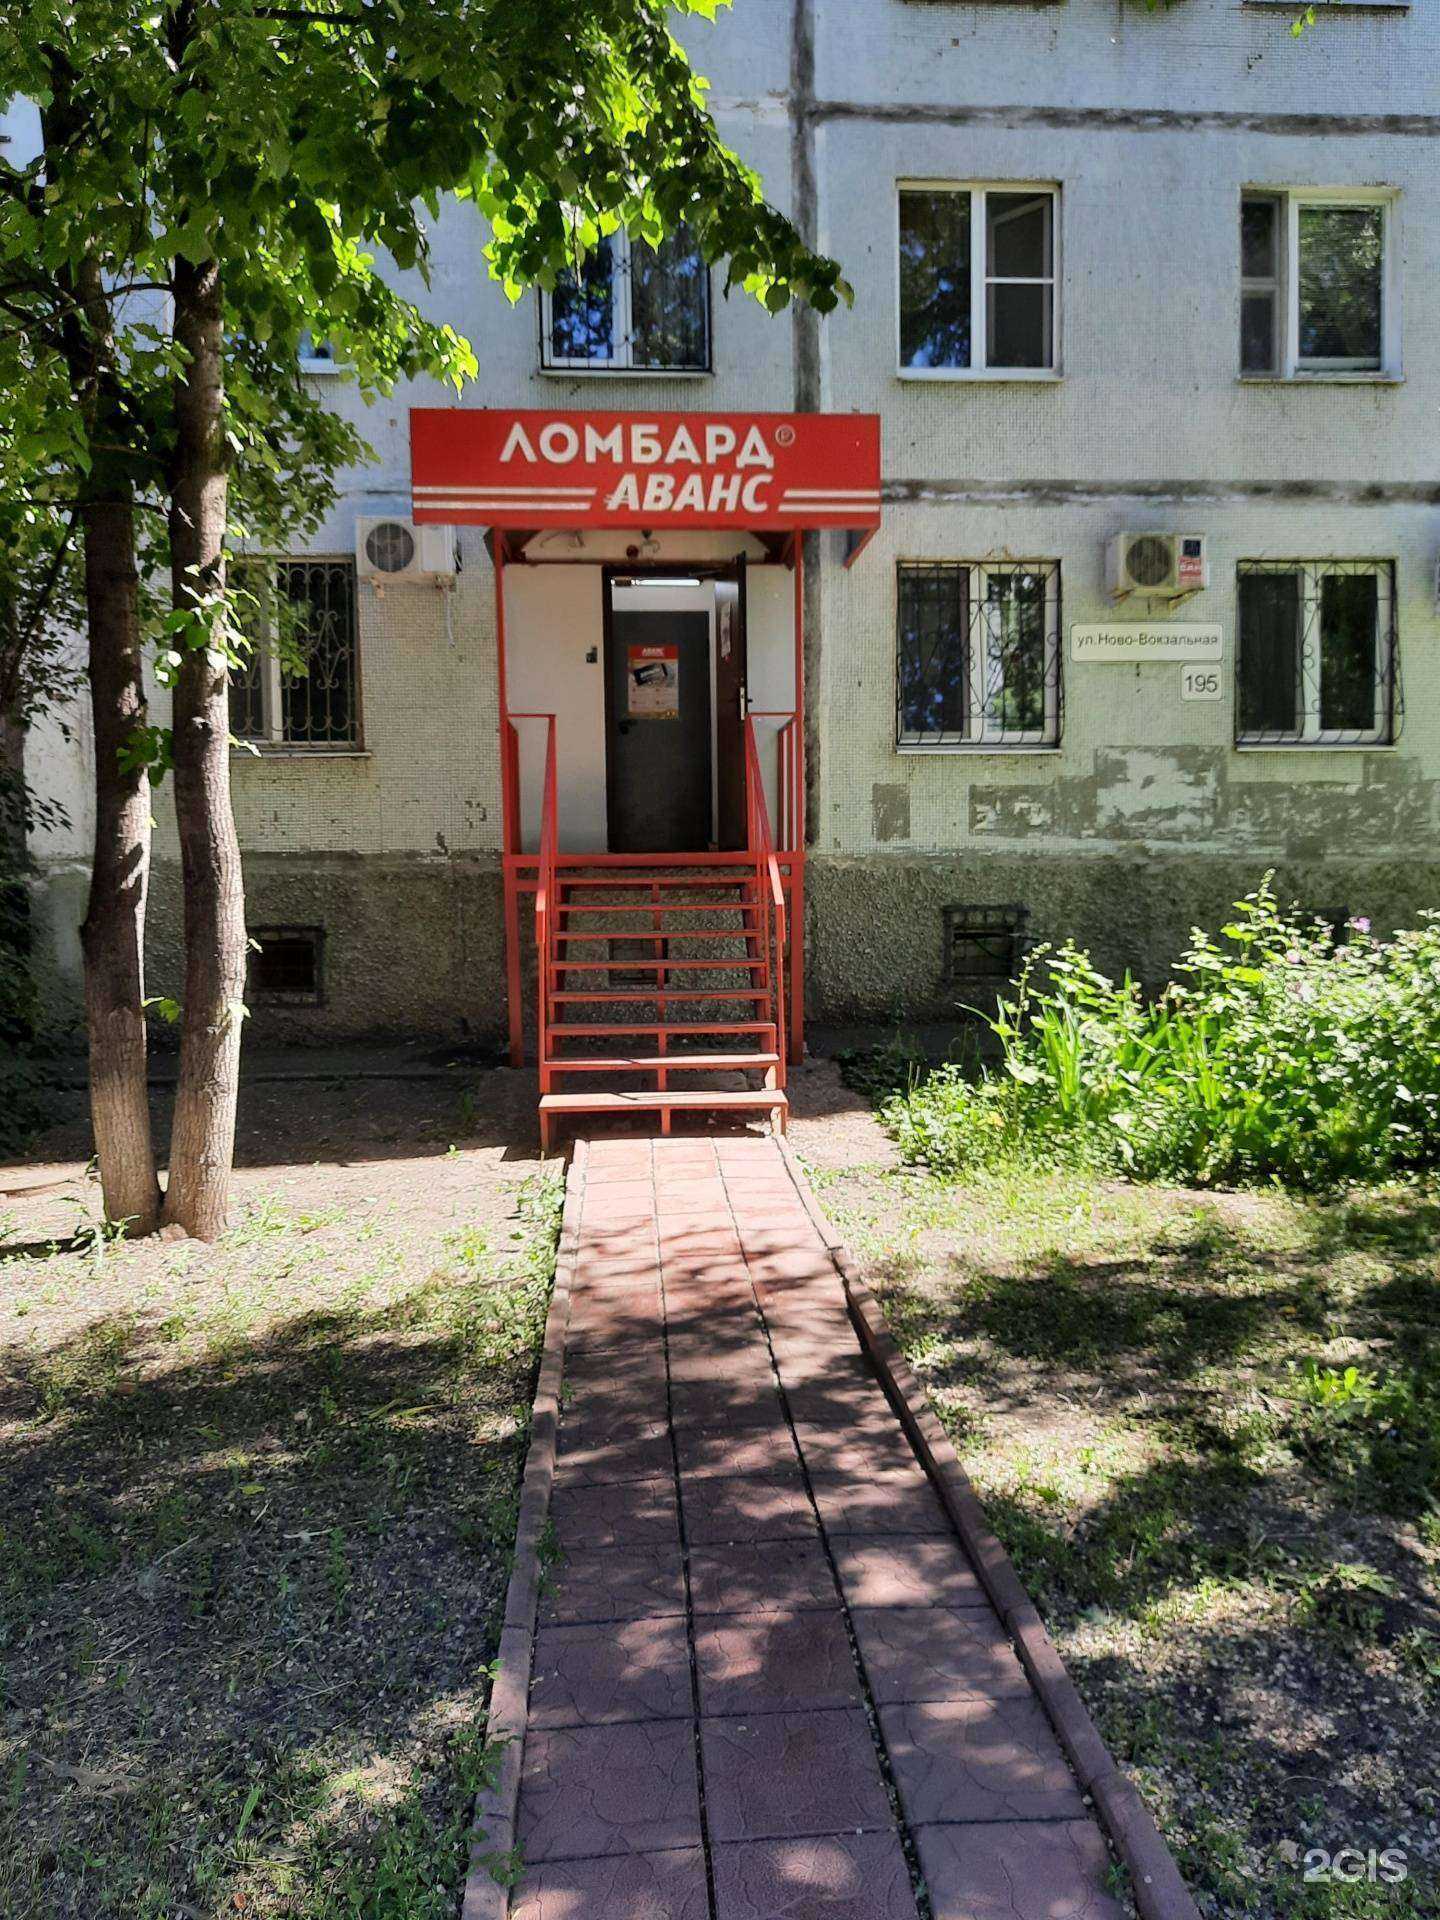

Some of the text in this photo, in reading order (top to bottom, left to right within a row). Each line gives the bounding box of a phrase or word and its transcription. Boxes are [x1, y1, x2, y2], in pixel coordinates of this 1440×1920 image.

[499, 421, 775, 469] ЛОМБАРД
[604, 473, 774, 512] АВАНС
[1185, 675, 1218, 693] 195
